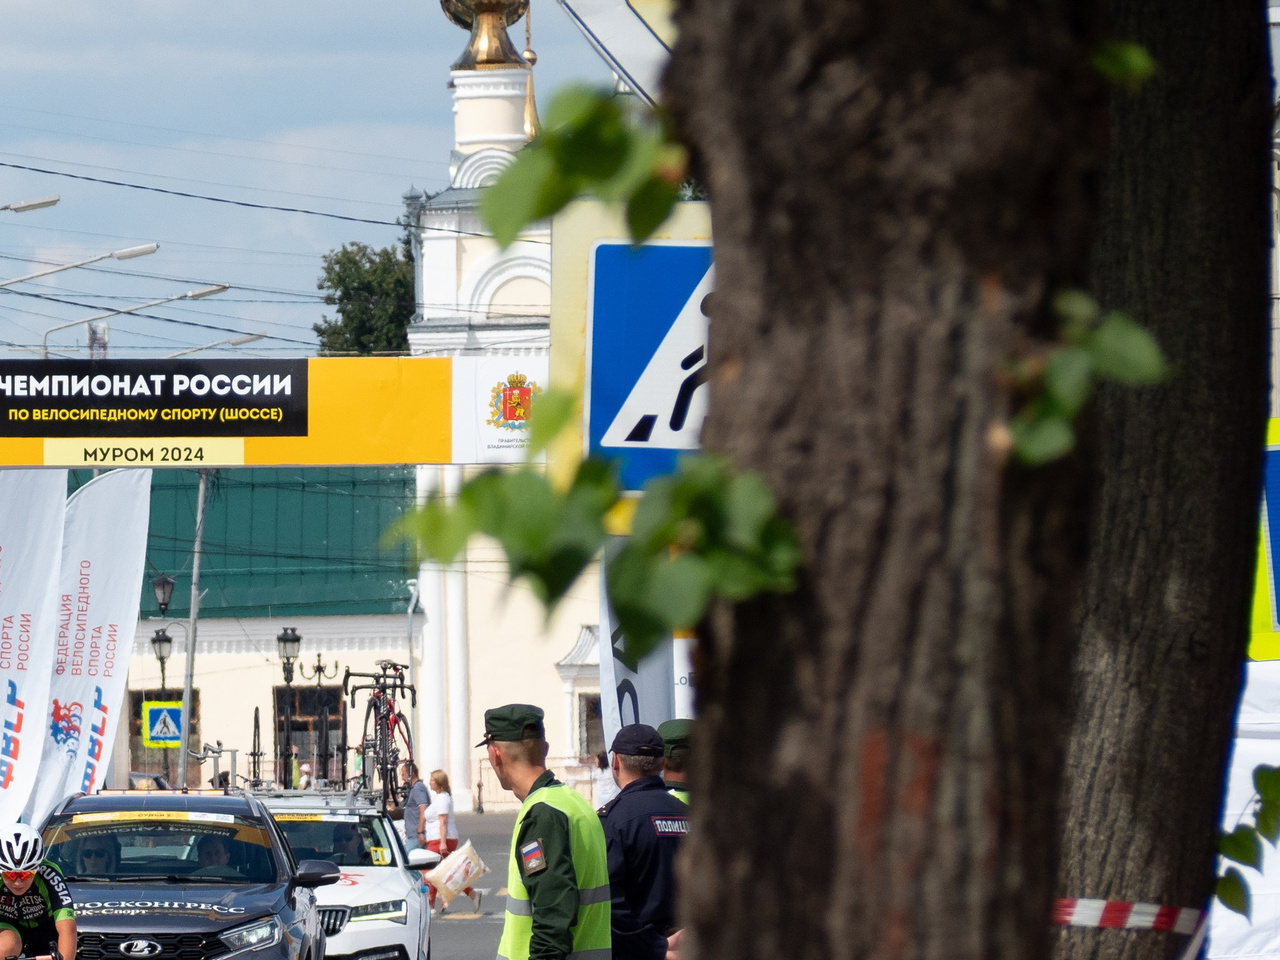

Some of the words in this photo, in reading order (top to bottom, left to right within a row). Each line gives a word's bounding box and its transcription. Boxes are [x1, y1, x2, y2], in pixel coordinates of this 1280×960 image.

[173, 374, 292, 396] РОССИИ
[9, 409, 29, 421] ПО
[33, 408, 158, 422] ВЕЛОСИПЕДНОМУ
[161, 408, 216, 421] СПОРТУ
[220, 408, 283, 423] (ШОССЕ)
[83, 448, 154, 463] МУРОМ
[161, 447, 204, 462] 2024
[0, 615, 15, 669] СПОРТА
[17, 613, 32, 671] РОССИИ
[55, 594, 74, 676] ФЕДЕРАЦИЯ
[71, 559, 91, 676] ВЕЛОСИПЕДНОГО
[88, 625, 103, 677] СПОРТА
[103, 623, 119, 678] РОССИИ
[40, 865, 73, 906] RUSSIA
[73, 901, 245, 914] РОСКОНГРЕСС
